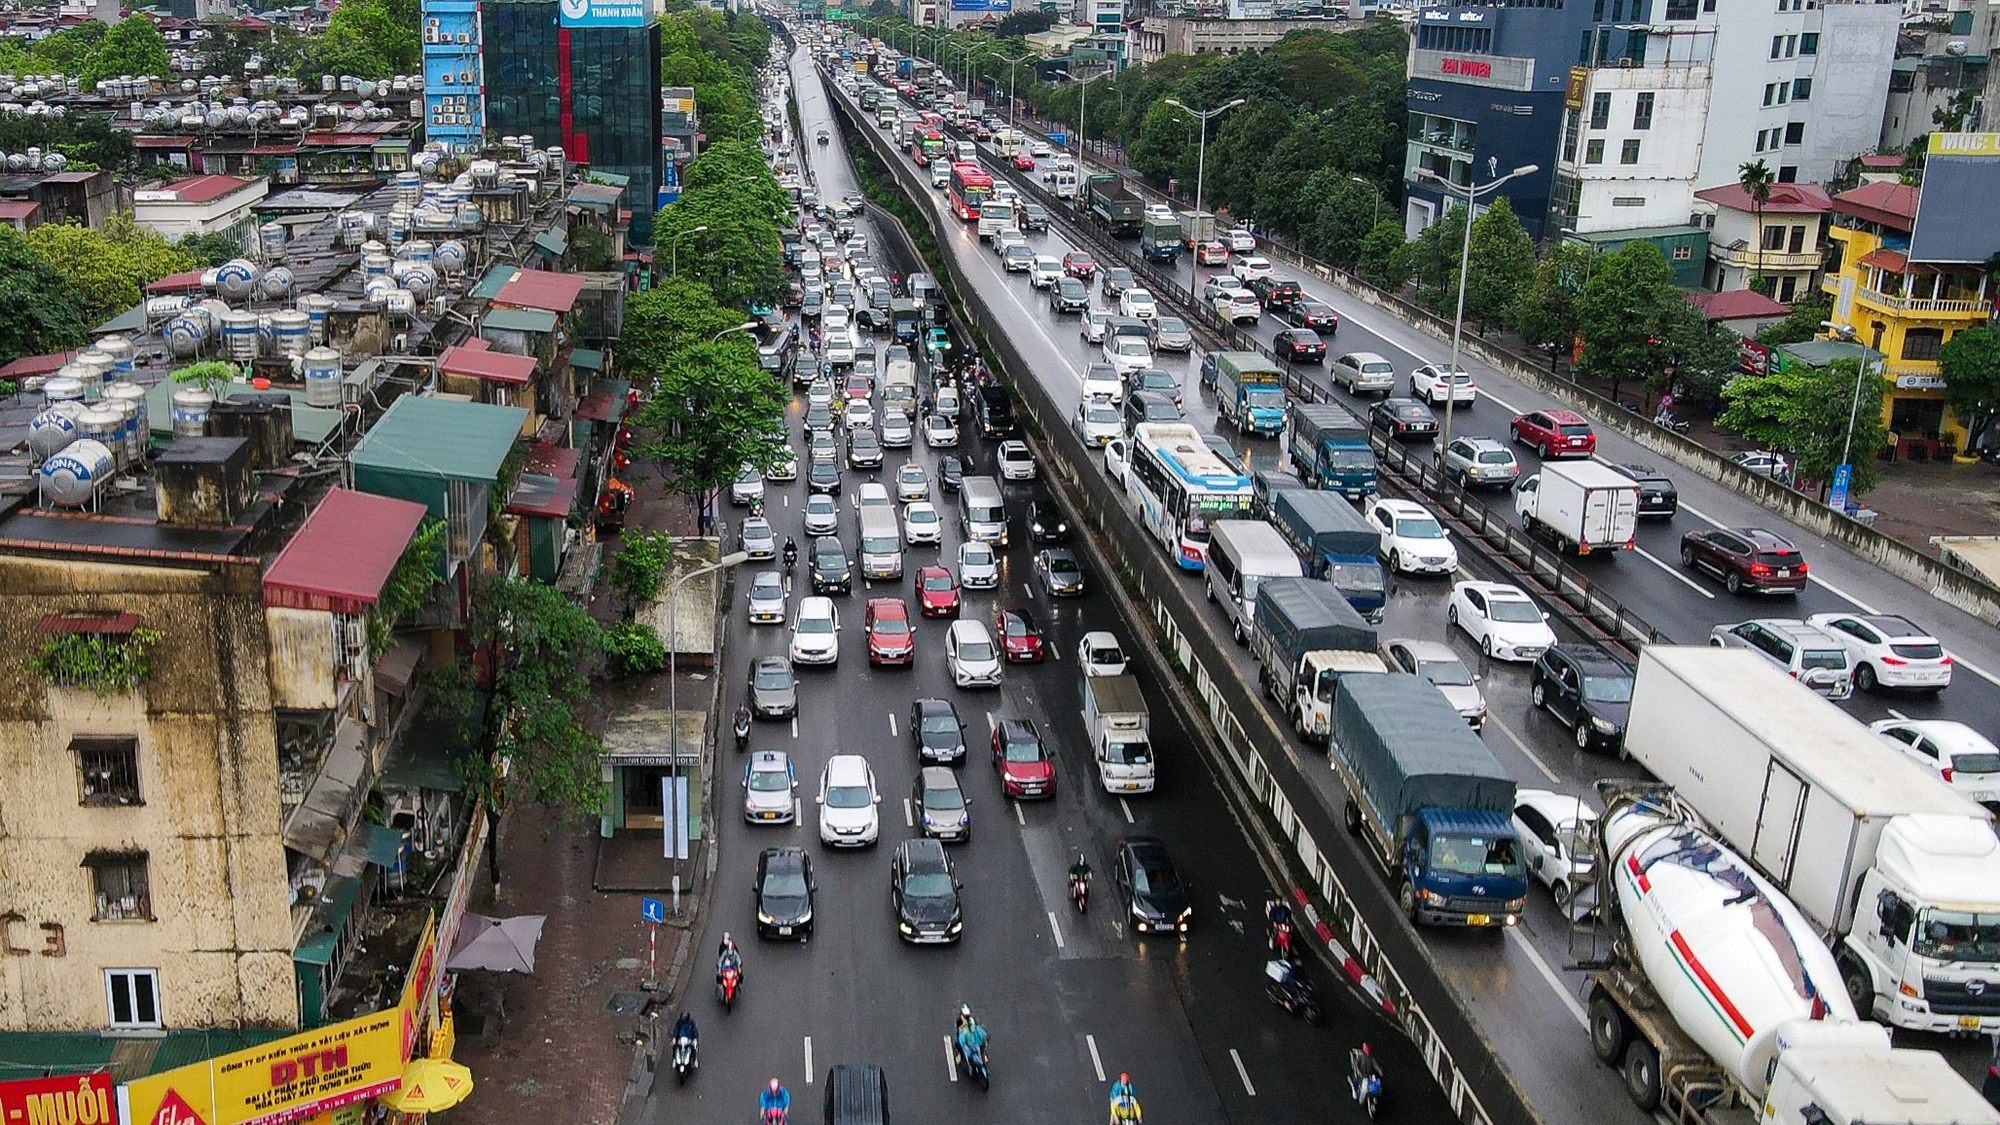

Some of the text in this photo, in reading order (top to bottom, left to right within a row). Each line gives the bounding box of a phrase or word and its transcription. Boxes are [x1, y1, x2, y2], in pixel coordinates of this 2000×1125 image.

[592, 6, 643, 17] THANH XUÂN
[1440, 58, 1491, 78] ZEN TOWER
[221, 1062, 243, 1073] CÔNG
[334, 1031, 350, 1041] LIỆU
[354, 1025, 367, 1036] XÂY
[370, 1020, 390, 1031] DỰNG
[270, 1044, 348, 1086] DTH
[262, 1090, 272, 1100] LÝ
[274, 1082, 298, 1096] PHÂN
[323, 1069, 349, 1081] CHÍNH
[299, 1086, 315, 1098] XÂY
[319, 1079, 341, 1092] DỰNG
[26, 1076, 110, 1125] MUỖI
